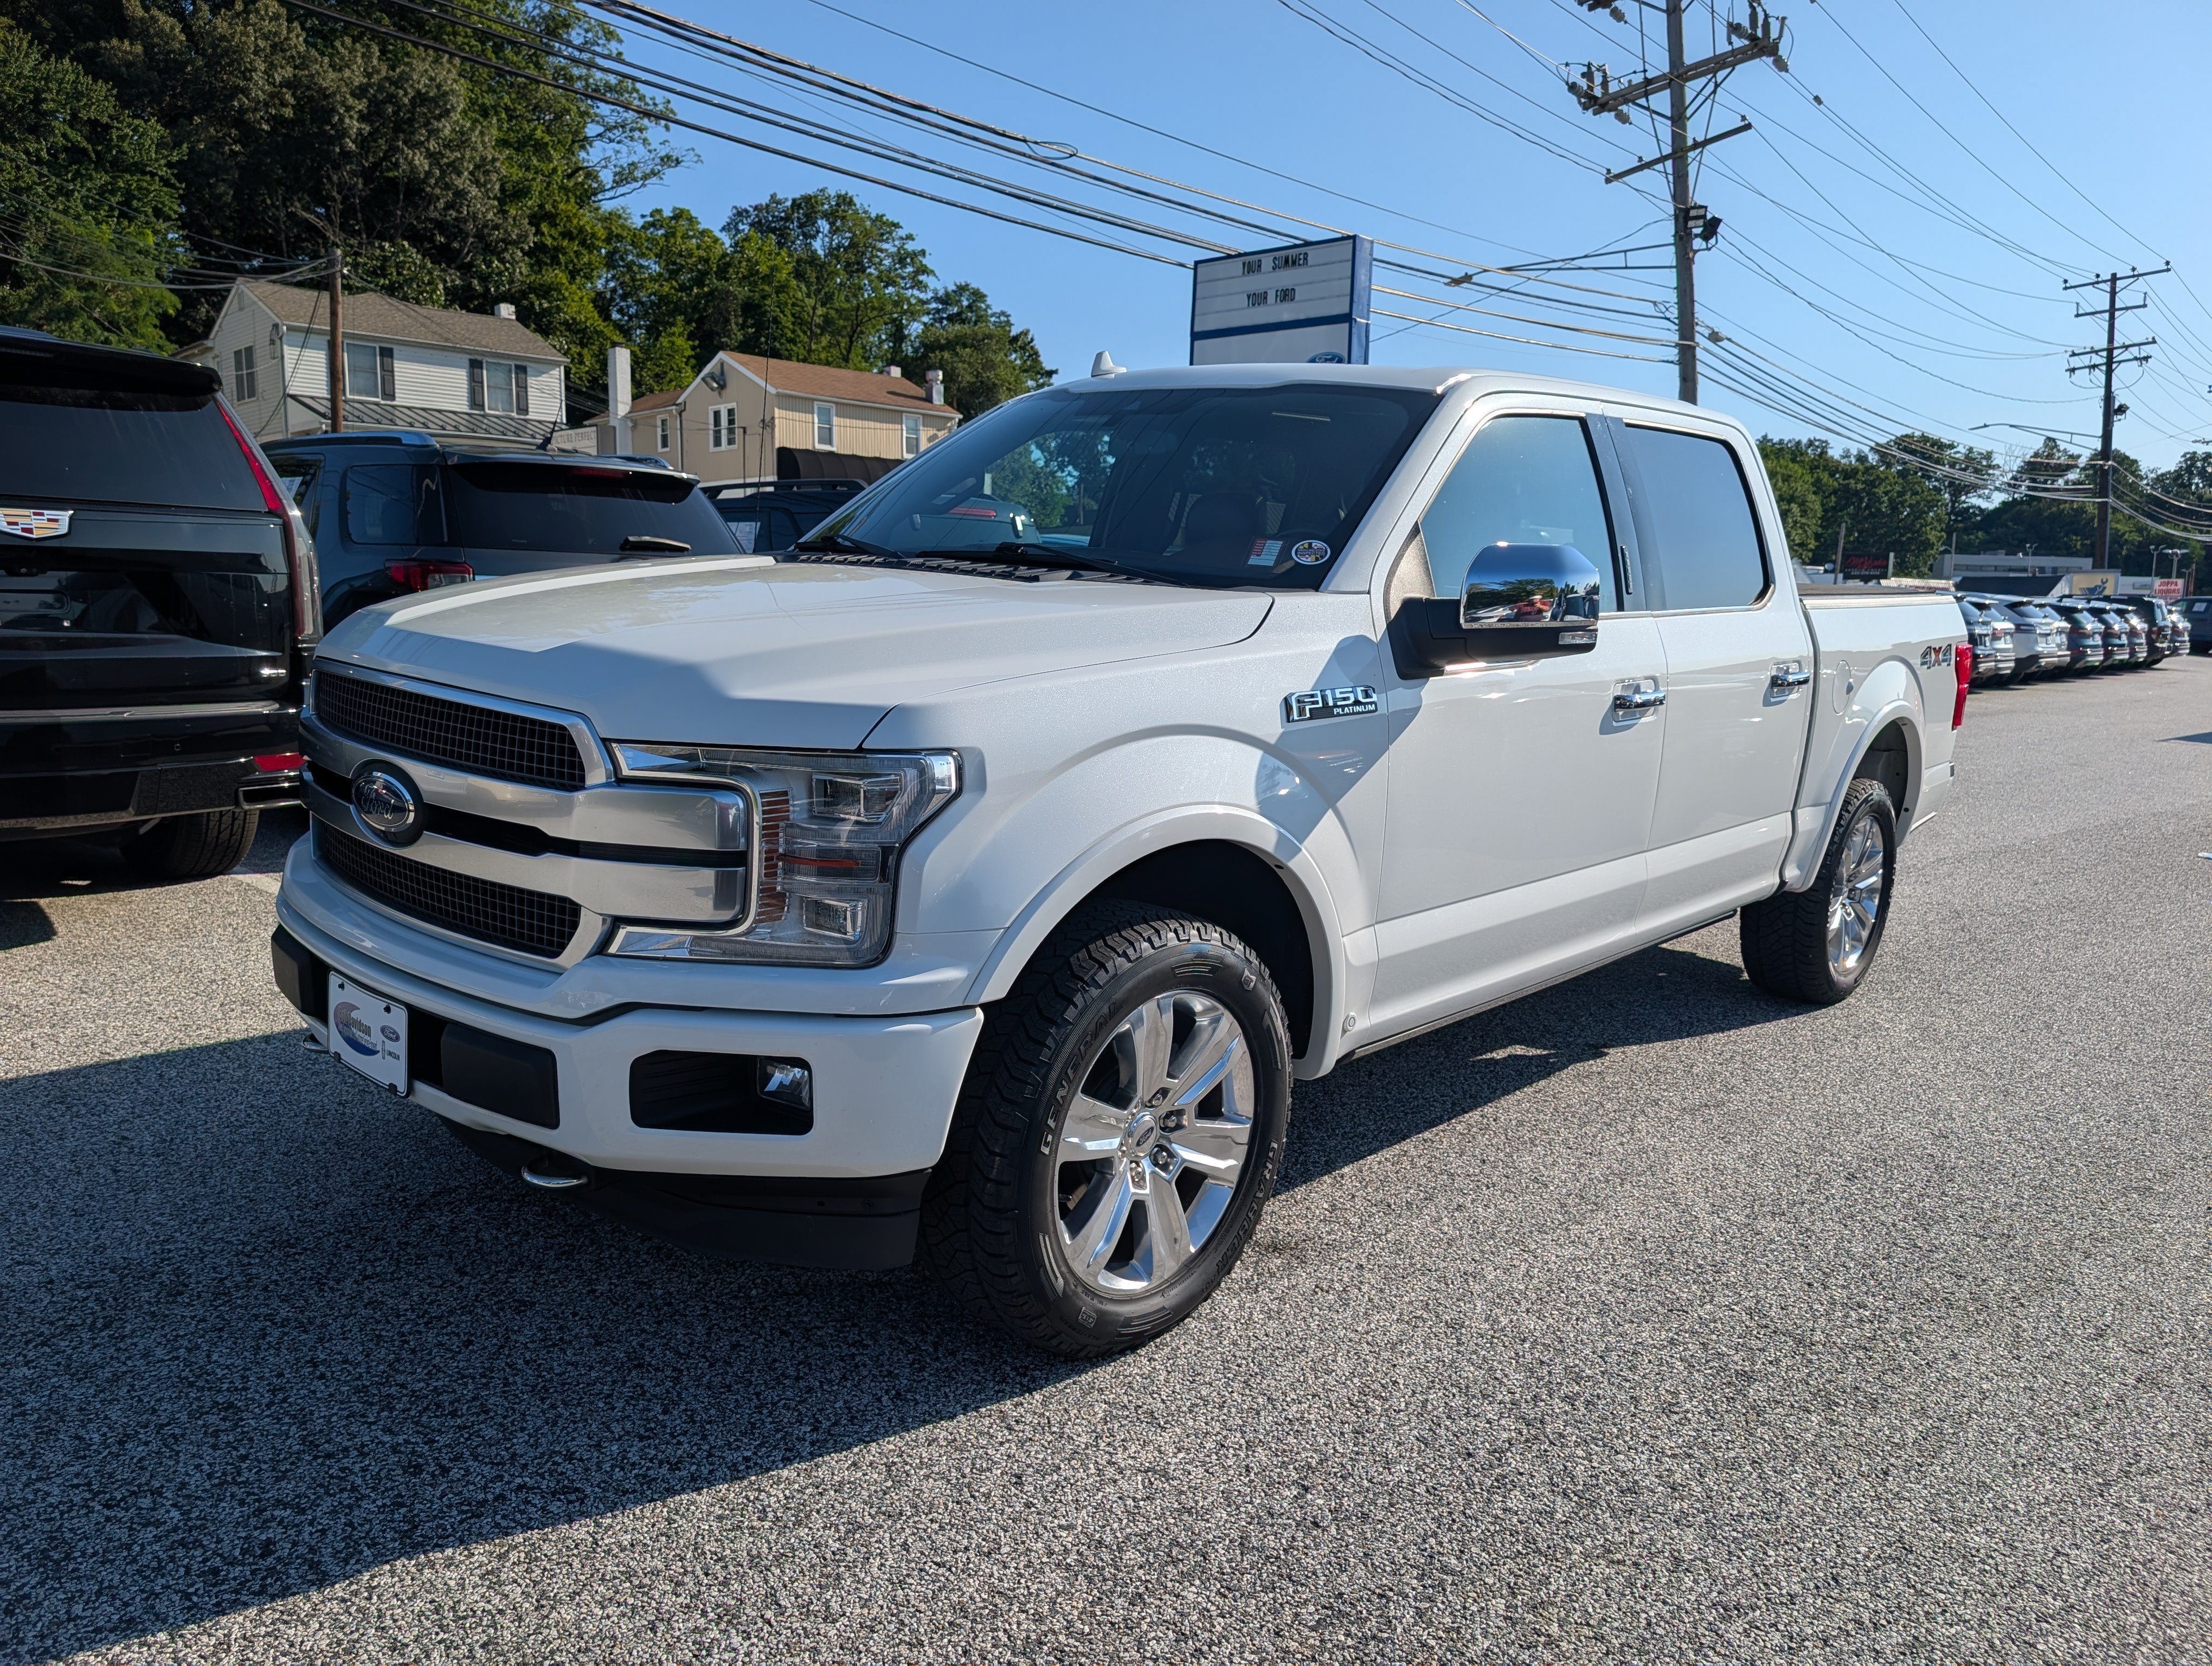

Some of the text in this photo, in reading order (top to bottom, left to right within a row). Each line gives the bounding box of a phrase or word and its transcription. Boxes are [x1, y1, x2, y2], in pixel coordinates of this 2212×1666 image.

[1242, 252, 1309, 275] YOUR SUMMER
[1246, 287, 1296, 307] YOUR FORD
[1334, 704, 1375, 715] PLATINUM
[361, 783, 394, 819] Ford
[347, 1011, 371, 1039] Davidson
[384, 1027, 397, 1041] Ford
[386, 1048, 400, 1061] LINCOLN
[1040, 1002, 1124, 1156] GENERAL
[1215, 1139, 1278, 1275] GRABBER
